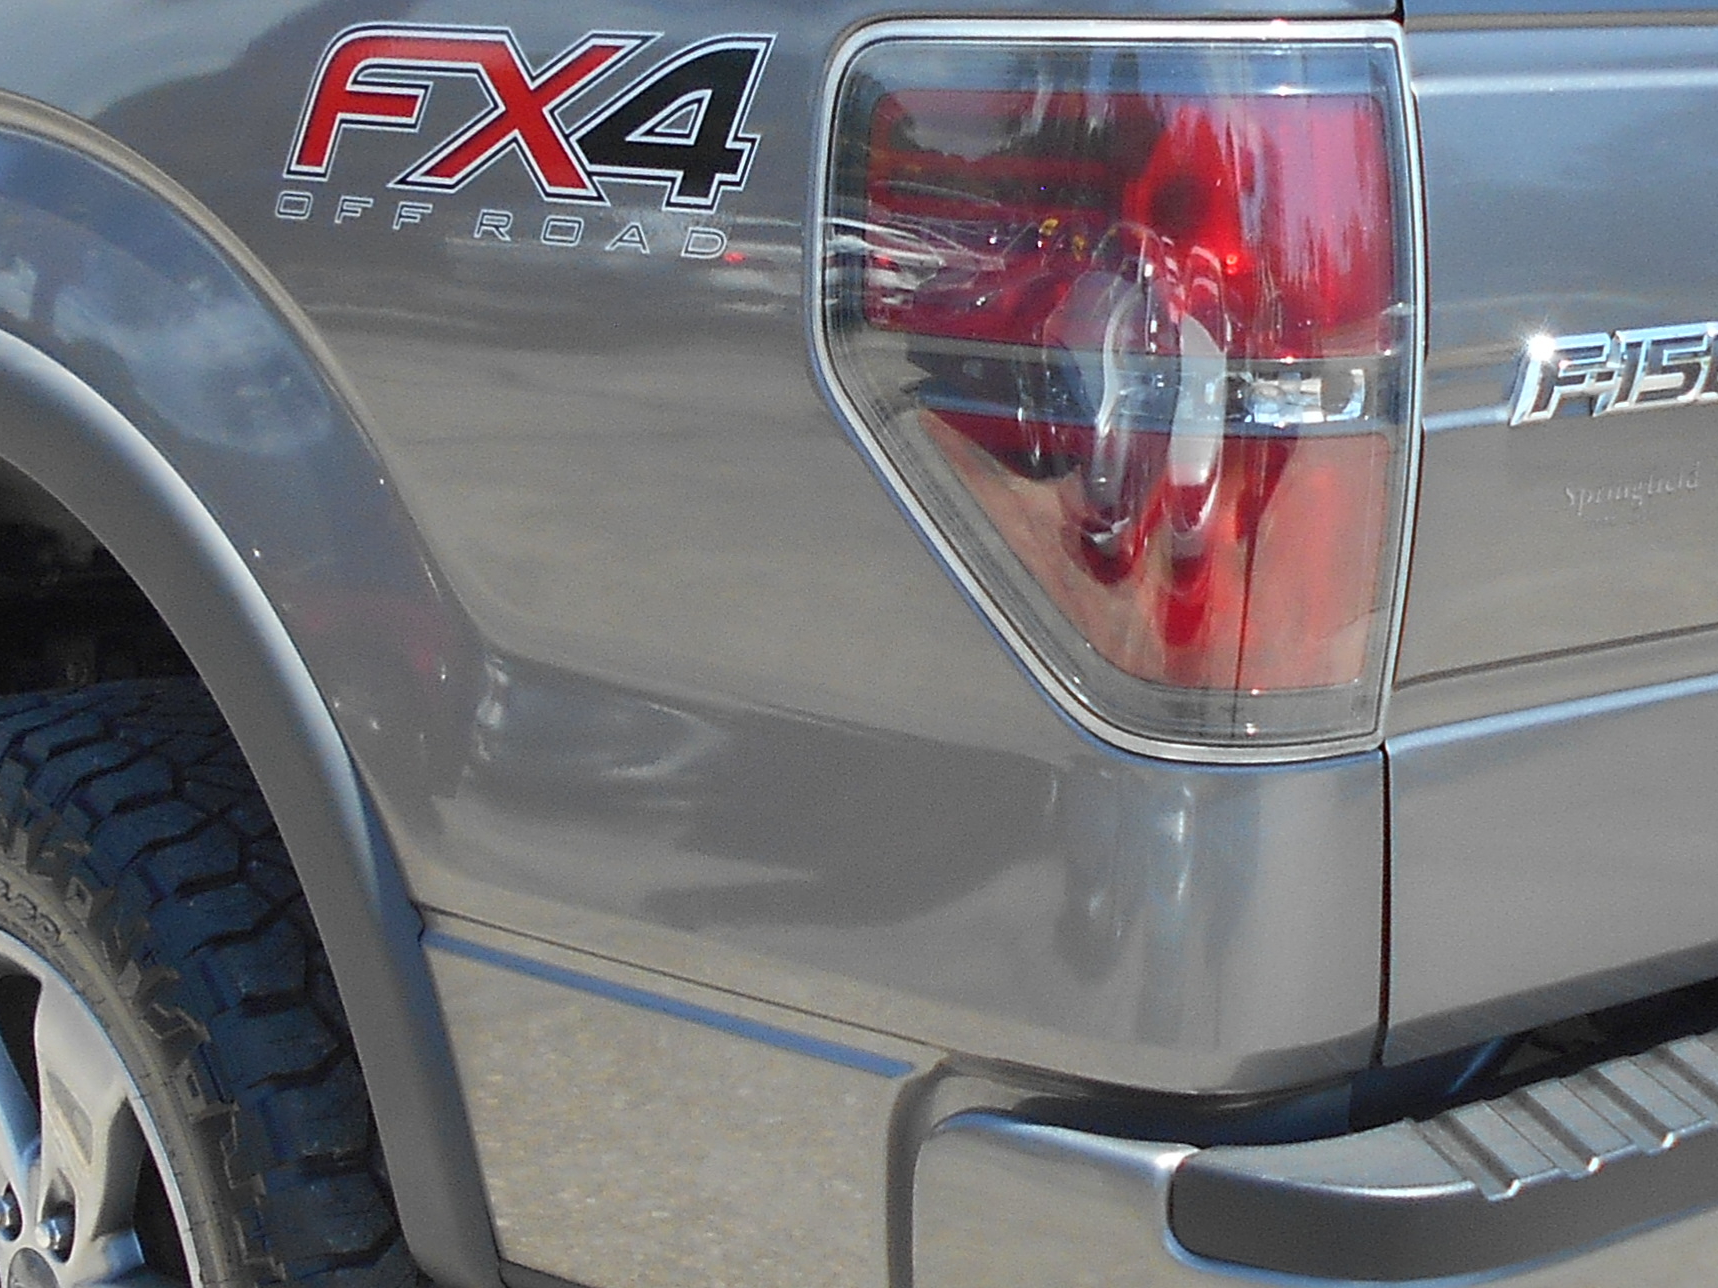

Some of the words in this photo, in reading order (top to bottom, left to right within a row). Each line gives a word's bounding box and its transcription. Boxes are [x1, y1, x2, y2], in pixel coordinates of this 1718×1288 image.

[283, 21, 777, 212] FX4
[274, 190, 433, 230] OFF
[473, 210, 729, 261] ROAD
